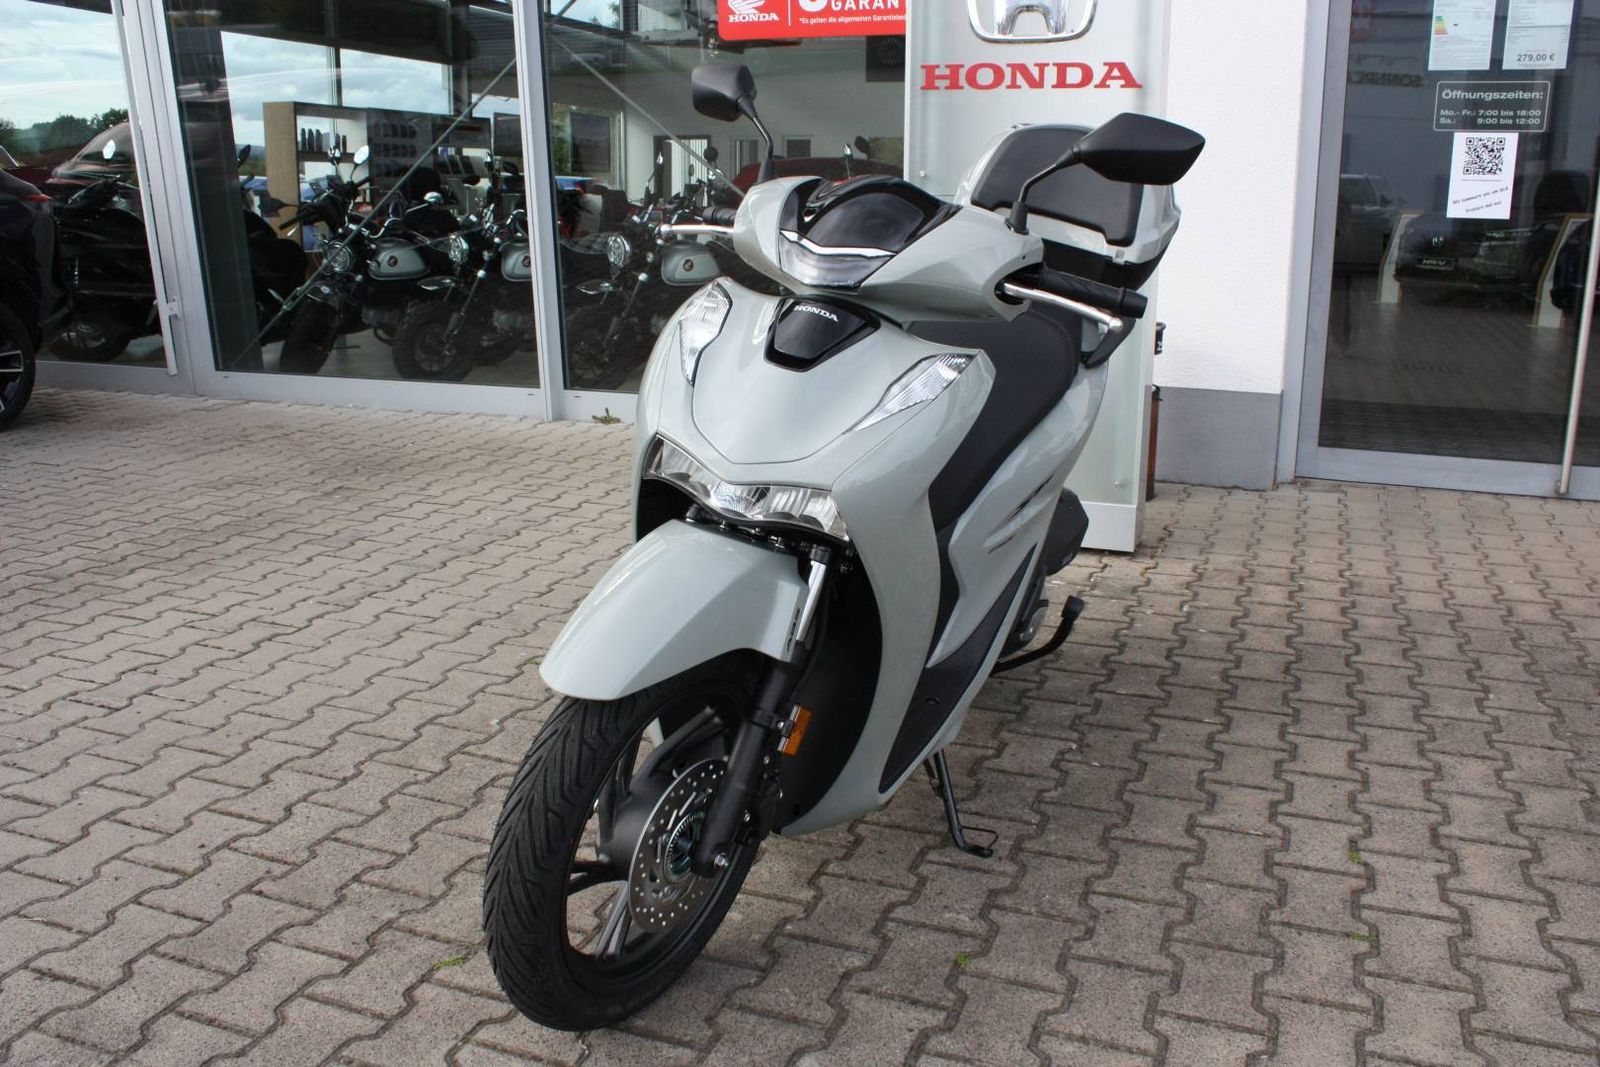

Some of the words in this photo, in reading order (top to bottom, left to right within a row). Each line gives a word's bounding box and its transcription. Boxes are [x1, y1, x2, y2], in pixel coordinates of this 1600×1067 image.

[728, 13, 779, 23] HONDA
[1516, 53, 1547, 63] 279,00
[1549, 53, 1556, 62] €
[920, 62, 1143, 90] HONDA
[1442, 88, 1544, 101] Öffnungszeiten:
[1478, 109, 1499, 117] 7:00
[1500, 109, 1514, 117] bis
[1499, 117, 1513, 125] bis
[1515, 117, 1541, 125] 12:00
[794, 305, 839, 322] HONDA
